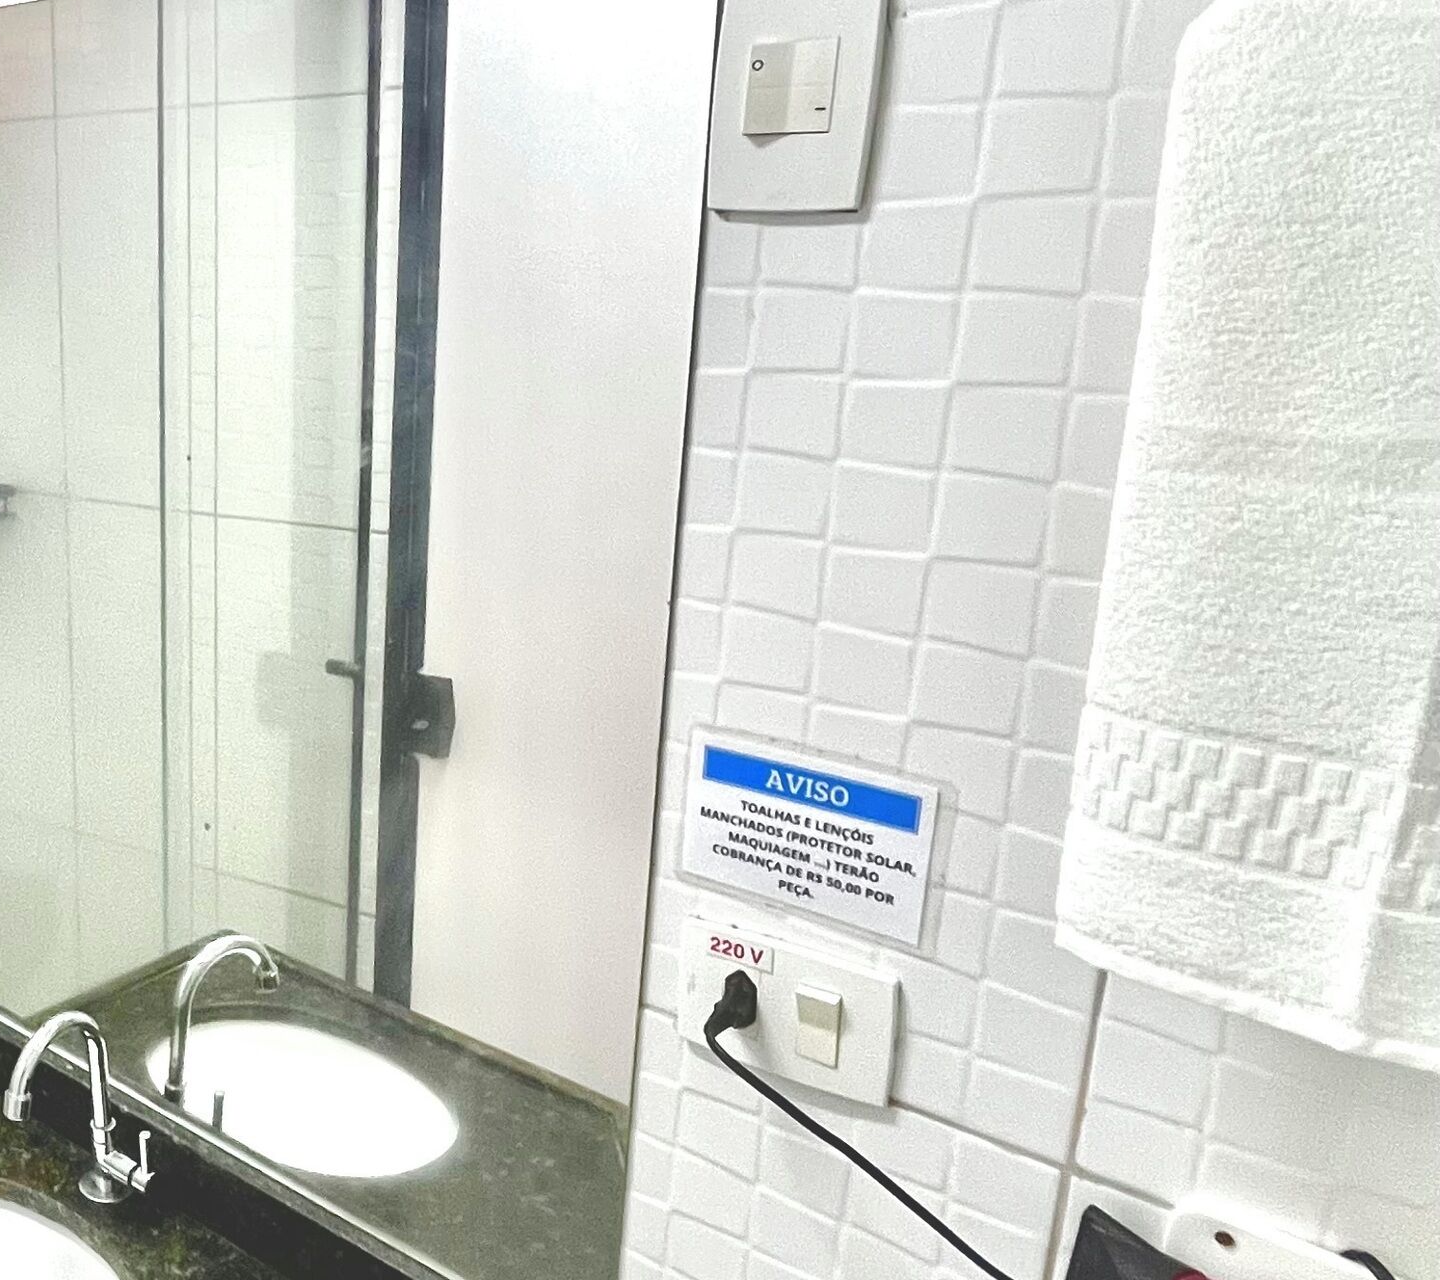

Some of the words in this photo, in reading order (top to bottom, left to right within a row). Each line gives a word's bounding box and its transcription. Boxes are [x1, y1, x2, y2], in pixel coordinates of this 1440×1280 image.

[765, 768, 850, 807] AVISO
[700, 806, 783, 838] MANCHADOS
[786, 830, 862, 860] (PROTETOR
[740, 799, 800, 826] TOALHAS
[804, 817, 812, 829] E
[815, 820, 874, 846] LENÇÓIS
[712, 843, 782, 873] COBRANÇA
[786, 864, 803, 879] DE
[806, 870, 823, 884] R$
[865, 887, 895, 906] POR
[728, 831, 811, 863] MAQUIAGEM
[834, 860, 879, 883] TERÃO
[710, 936, 745, 959] 220
[750, 946, 764, 965] V
